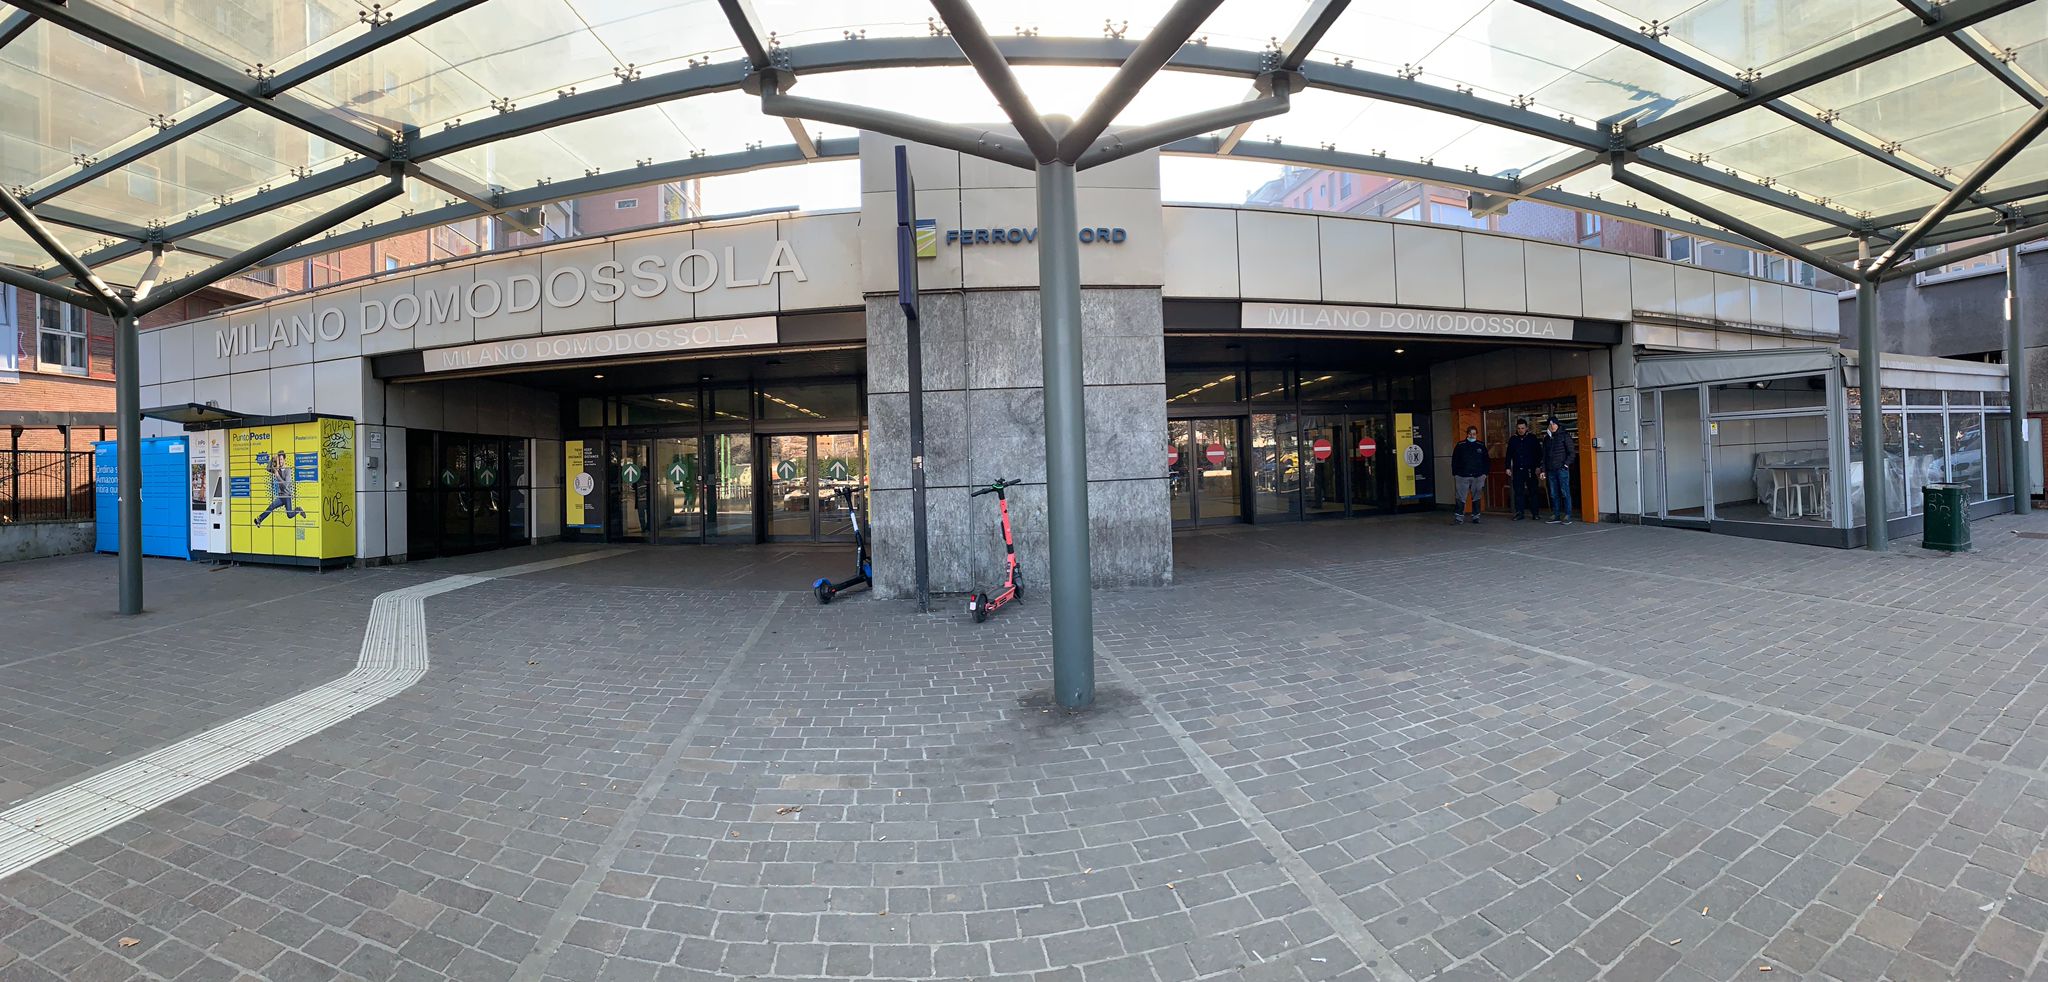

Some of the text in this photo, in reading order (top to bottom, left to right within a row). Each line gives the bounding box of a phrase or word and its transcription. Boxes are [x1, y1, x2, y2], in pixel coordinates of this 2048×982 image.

[946, 227, 1127, 246] FERROVORD
[215, 239, 808, 359] MILANO DOMODOSSOLA
[1267, 307, 1556, 337] MILANO DOMODOSSOLA
[442, 323, 749, 368] MILANO DOMODOSSOLA
[232, 432, 271, 442] PuntoPoste
